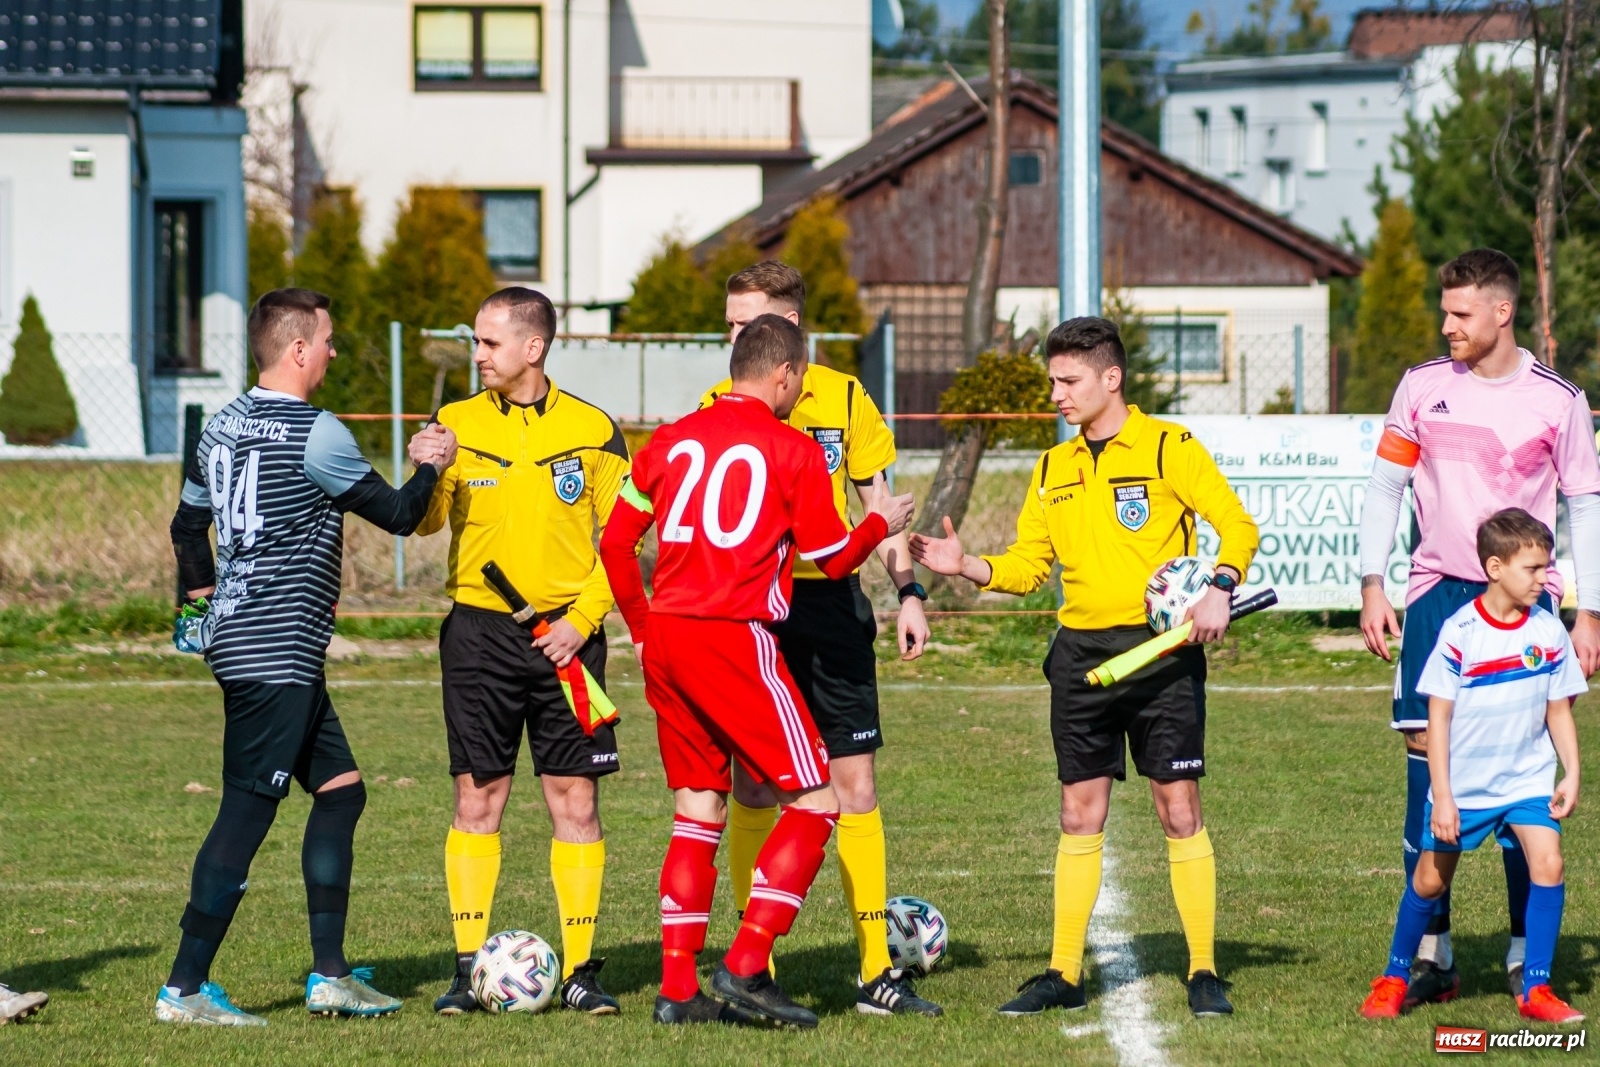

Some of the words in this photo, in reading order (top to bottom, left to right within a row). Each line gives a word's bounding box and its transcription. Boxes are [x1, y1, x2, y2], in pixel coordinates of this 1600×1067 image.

[221, 416, 291, 442] RASZCZYCE
[1214, 452, 1244, 466] Bau
[1260, 453, 1302, 466] K&M
[1307, 452, 1338, 466] Bau
[207, 443, 265, 548] 94
[661, 438, 767, 549] 20
[853, 729, 877, 740] zina
[592, 752, 618, 764] zina
[1172, 759, 1202, 769] zina
